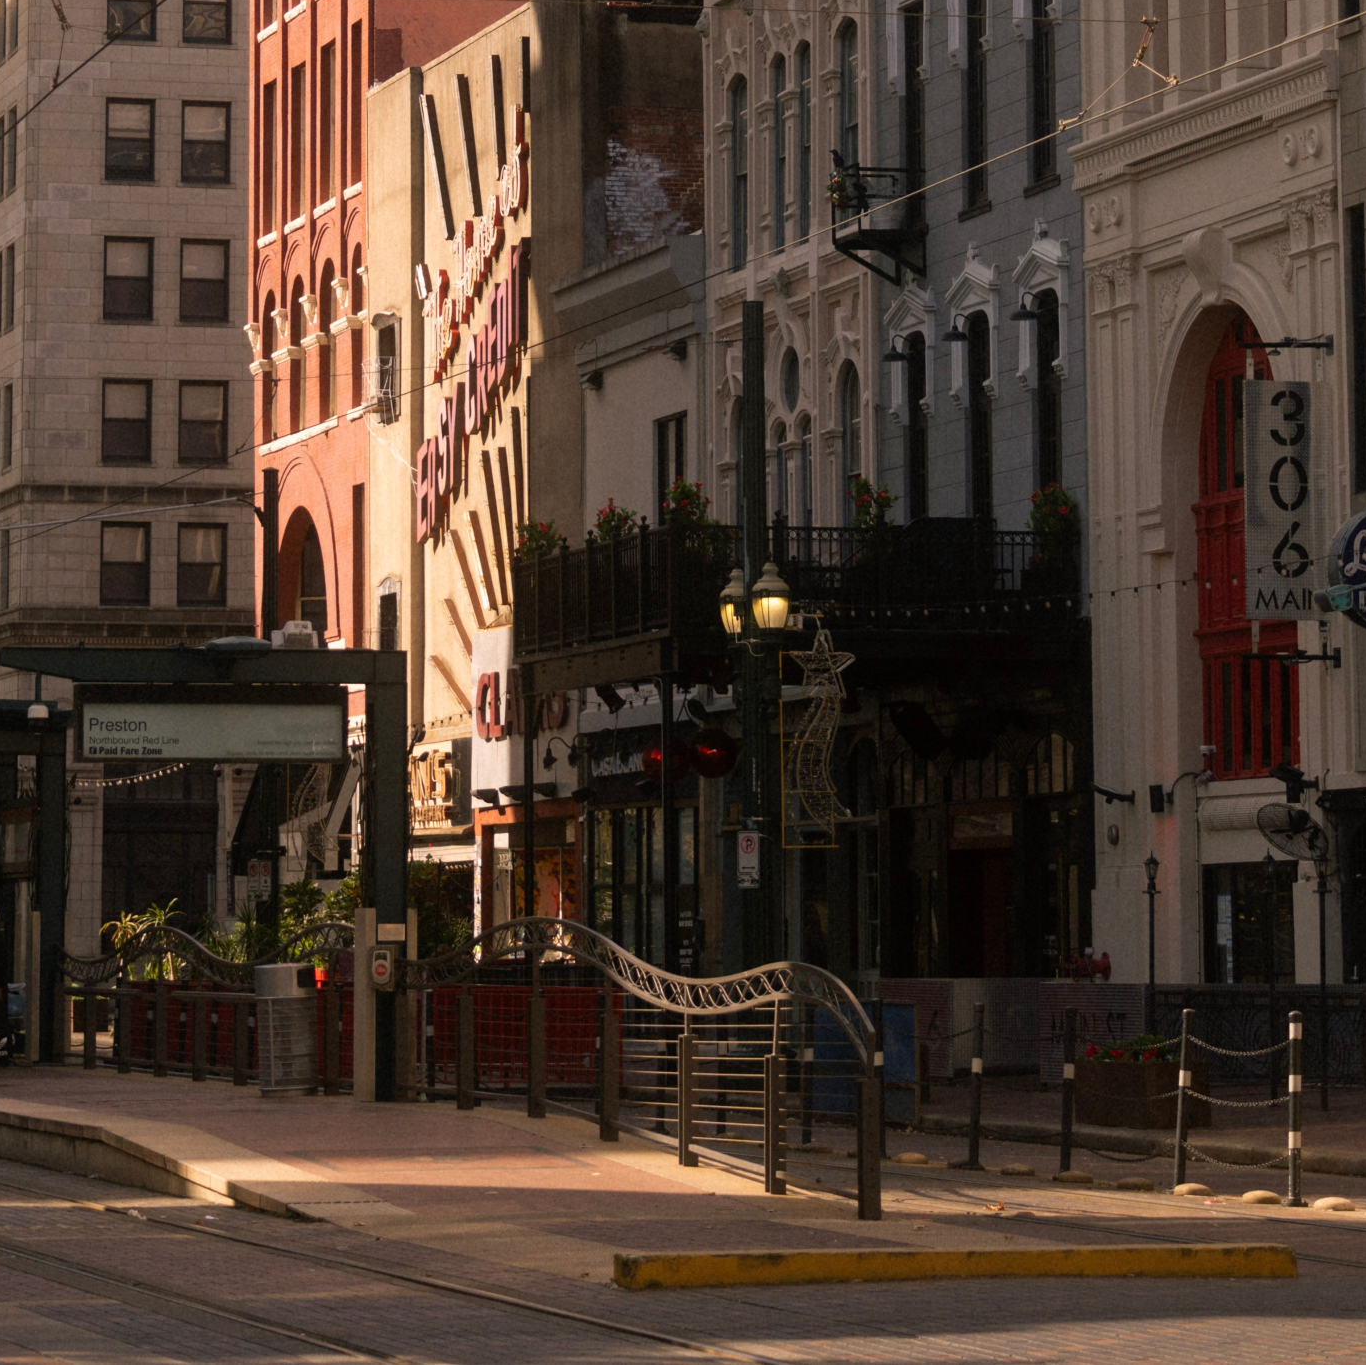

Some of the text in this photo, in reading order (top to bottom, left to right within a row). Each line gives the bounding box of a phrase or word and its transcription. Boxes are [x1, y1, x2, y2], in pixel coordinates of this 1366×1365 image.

[416, 237, 531, 543] EASY CREDIT
[1269, 390, 1309, 578] 306
[89, 718, 147, 732] Preston
[89, 736, 180, 745] Northbound Red Line
[99, 746, 163, 755] Paid Fare Zone
